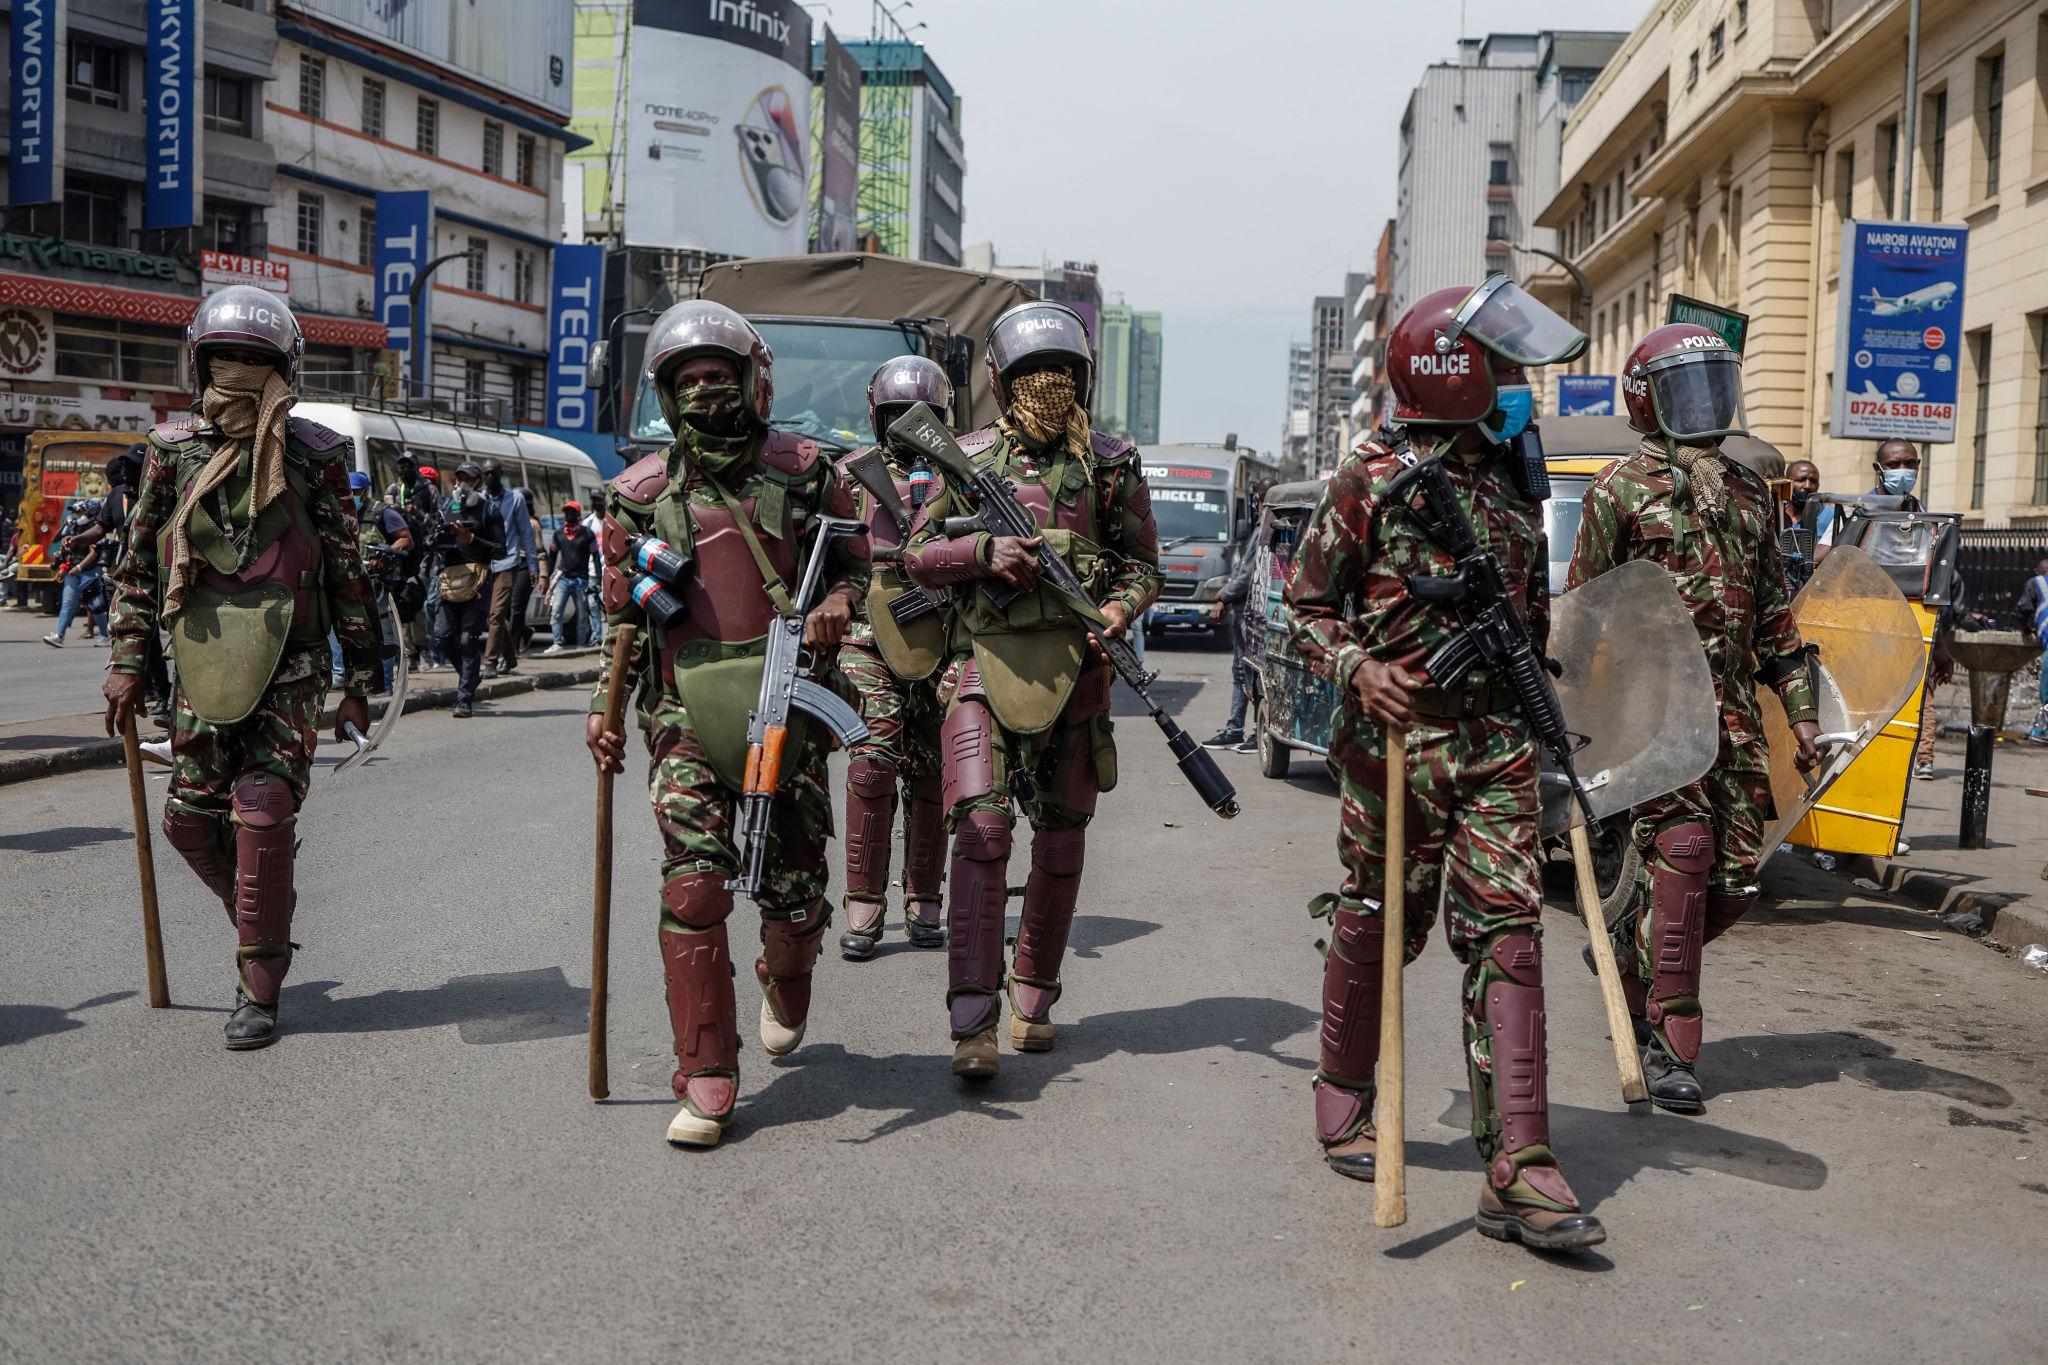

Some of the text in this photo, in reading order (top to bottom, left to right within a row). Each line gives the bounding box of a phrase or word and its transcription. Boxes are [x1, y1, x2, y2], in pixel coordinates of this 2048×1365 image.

[709, 0, 791, 46] Infinix
[1867, 232, 1957, 250] NAIROBI AVIATION
[1883, 246, 1940, 256] COLLEGE
[218, 255, 273, 277] CYBER
[1016, 318, 1064, 334] POLICE
[556, 277, 591, 428] TECNO
[1411, 354, 1470, 375] POLICE
[1622, 375, 1648, 397] POLICE
[1851, 401, 1952, 419] 0724 536 048
